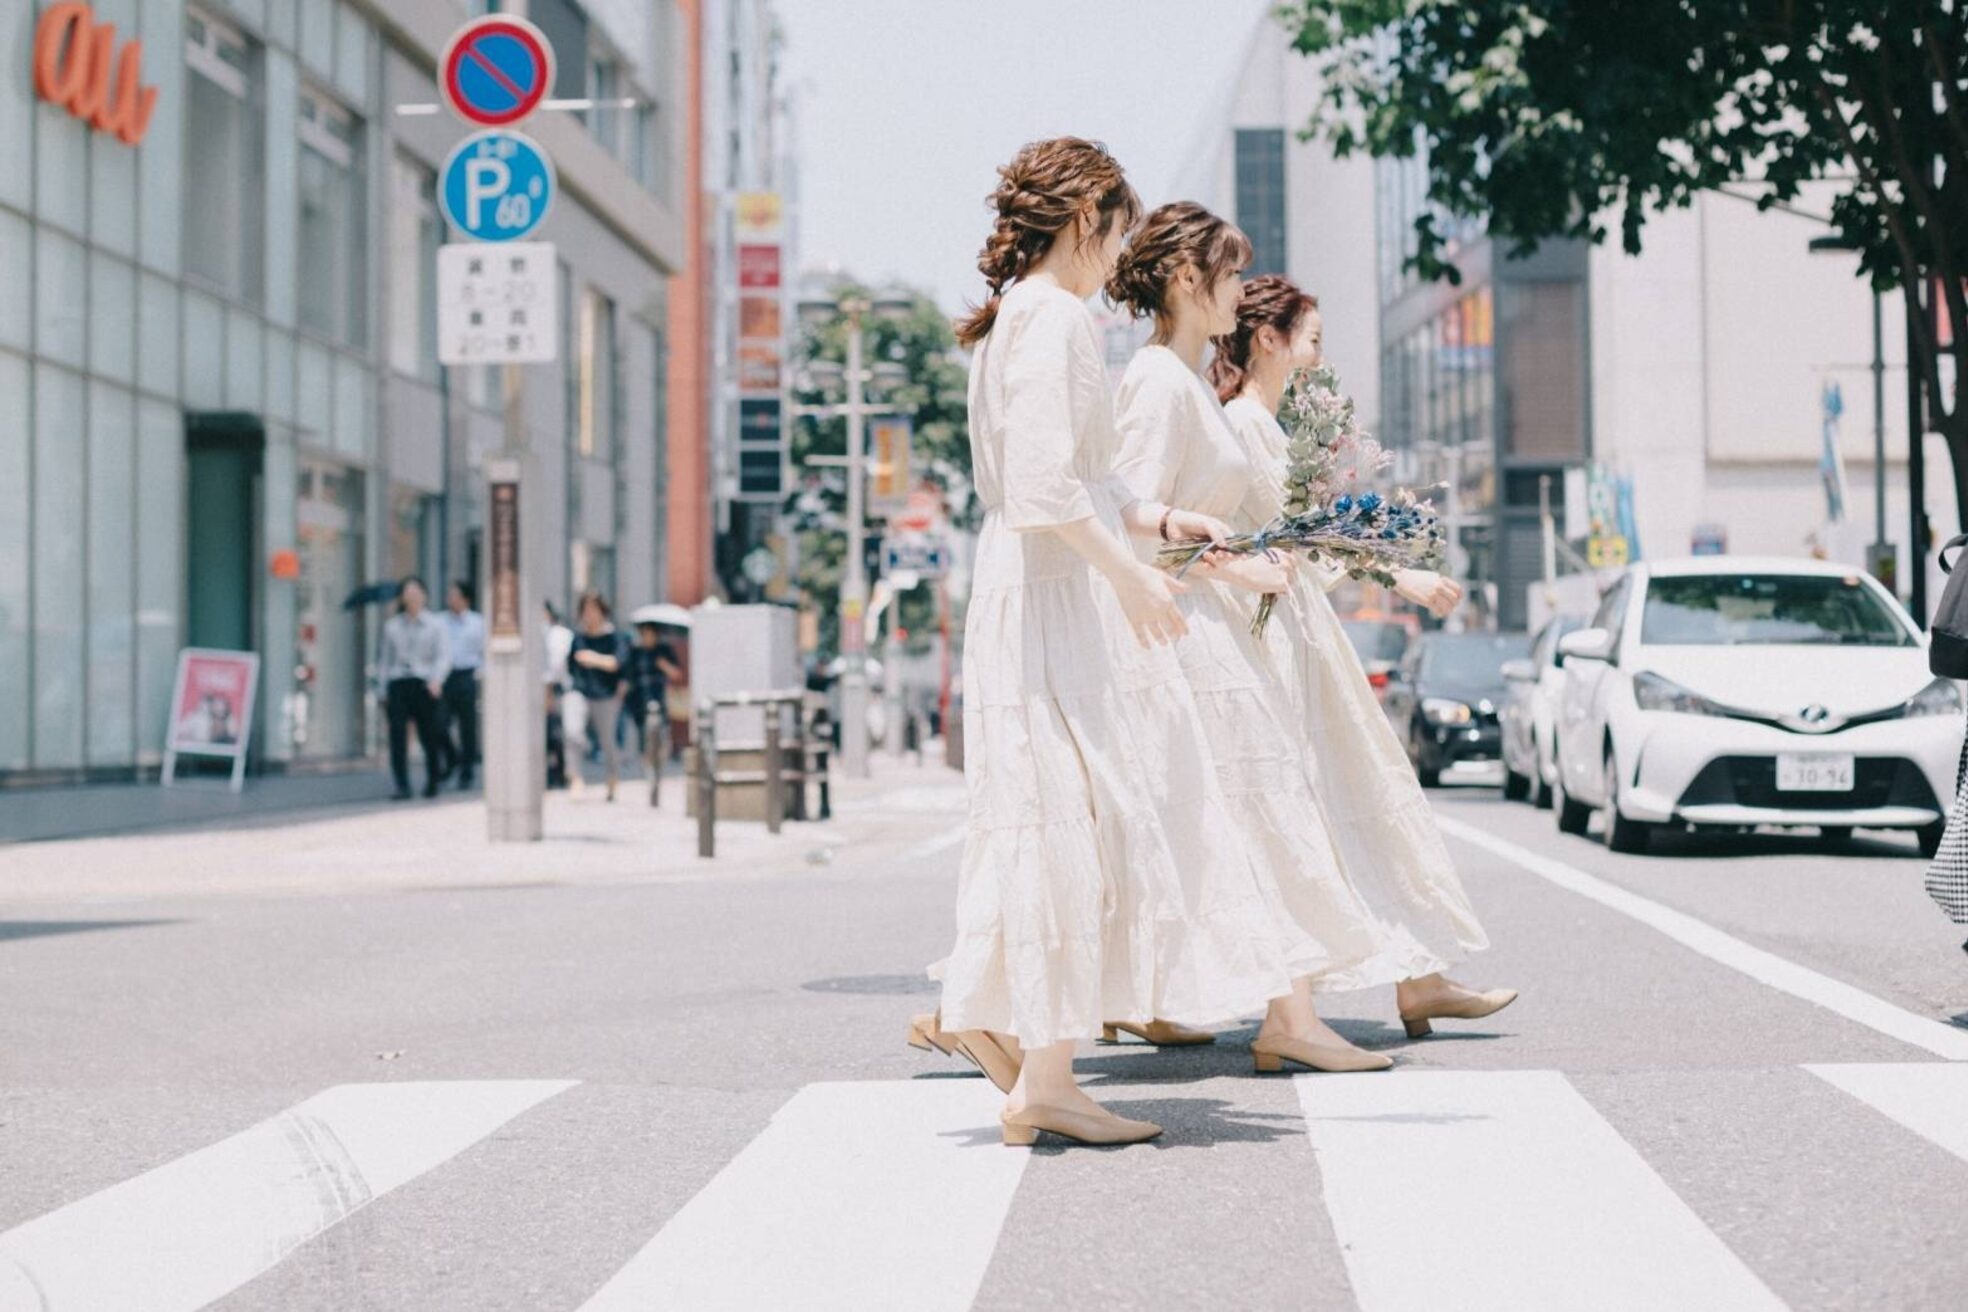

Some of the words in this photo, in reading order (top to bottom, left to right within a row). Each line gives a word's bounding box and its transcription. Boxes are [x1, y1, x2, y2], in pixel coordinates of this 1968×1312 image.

[33, 2, 158, 145] au
[466, 159, 511, 230] P
[496, 194, 531, 228] 60
